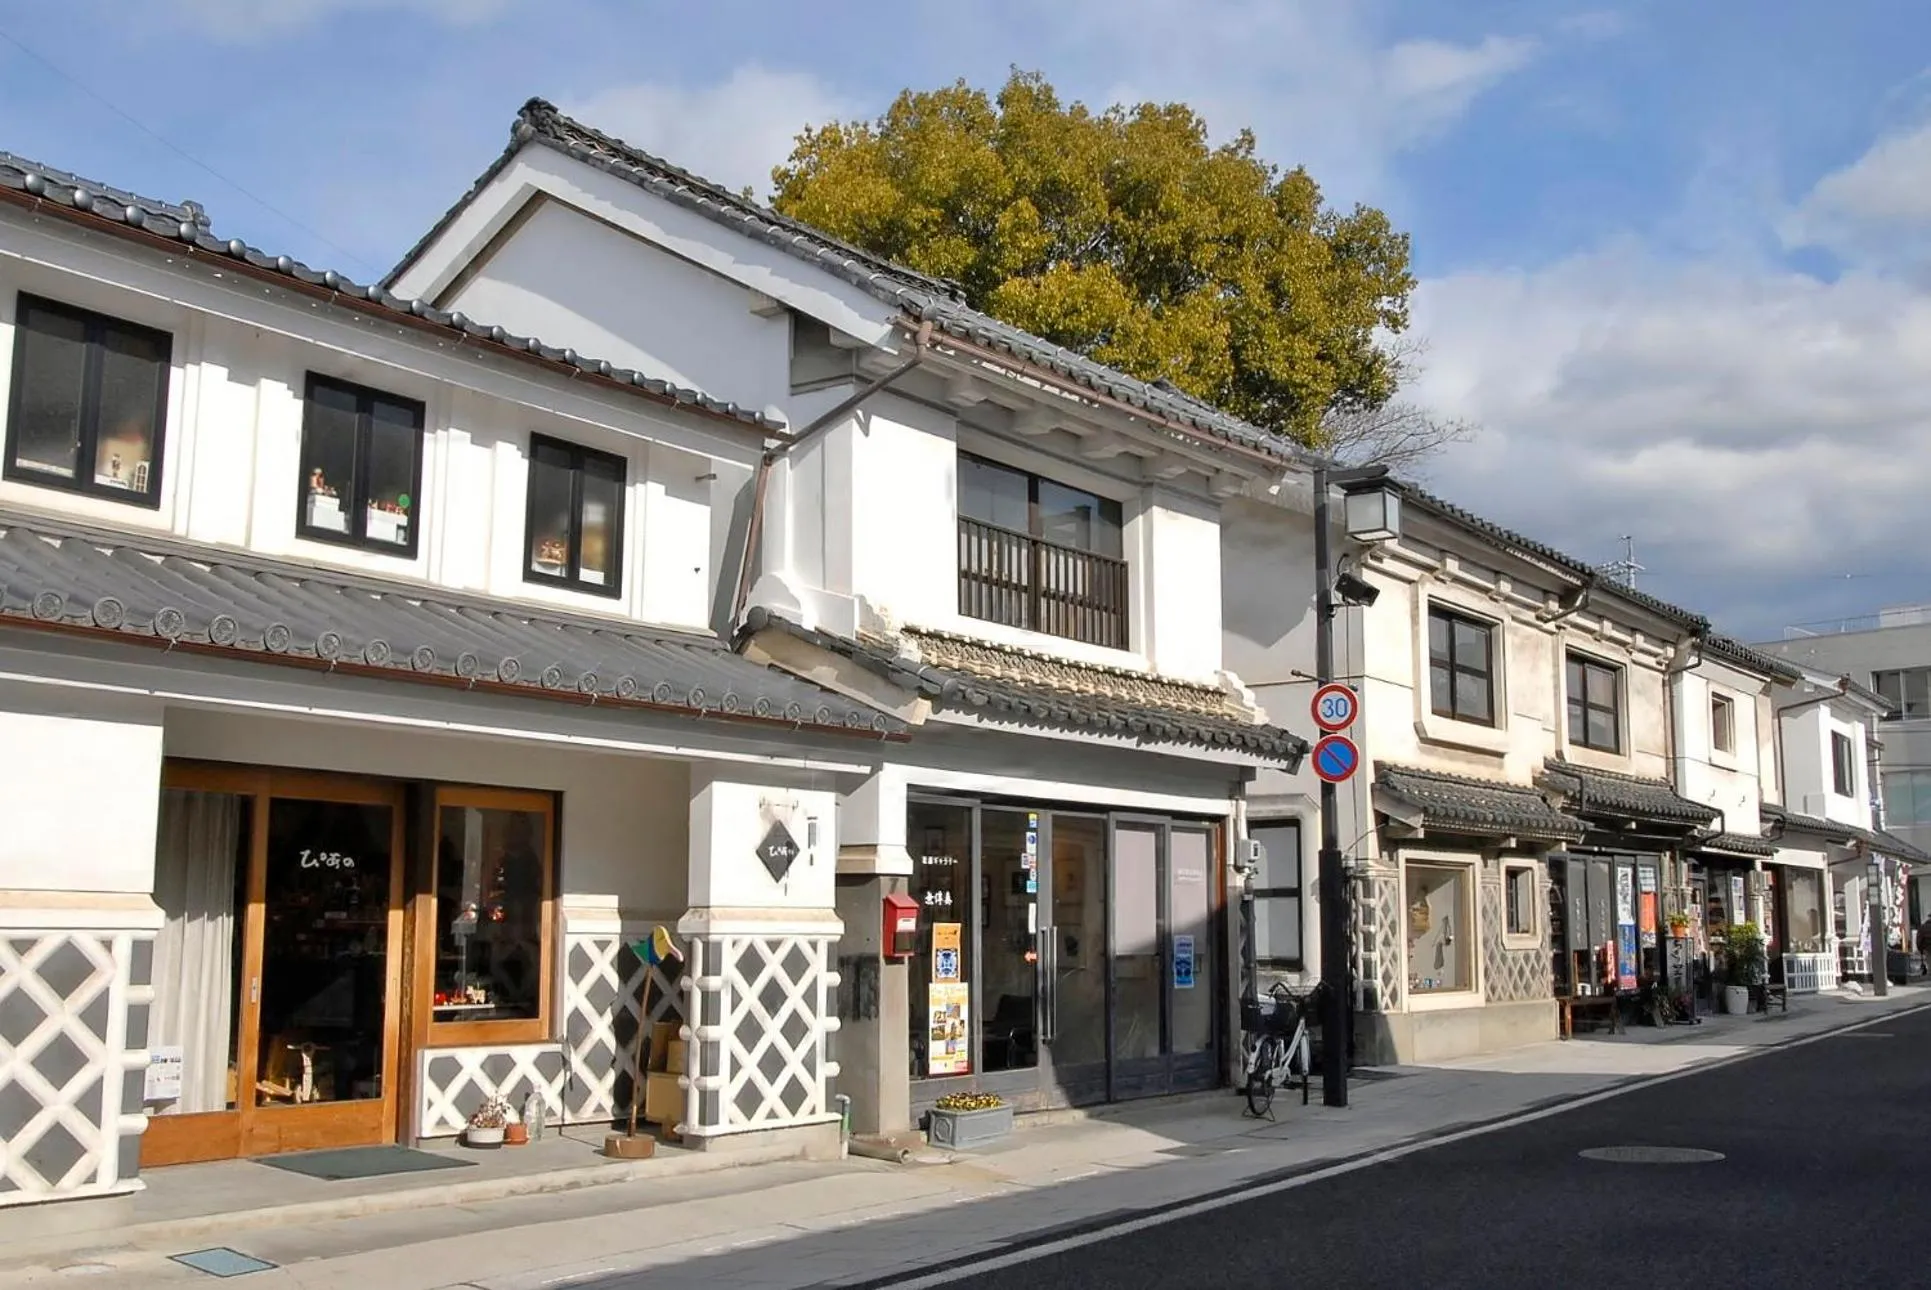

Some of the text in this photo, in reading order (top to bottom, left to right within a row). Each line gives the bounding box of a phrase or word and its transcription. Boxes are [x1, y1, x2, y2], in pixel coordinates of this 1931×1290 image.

[1322, 698, 1348, 718] 30
[299, 849, 355, 869] ぴあの
